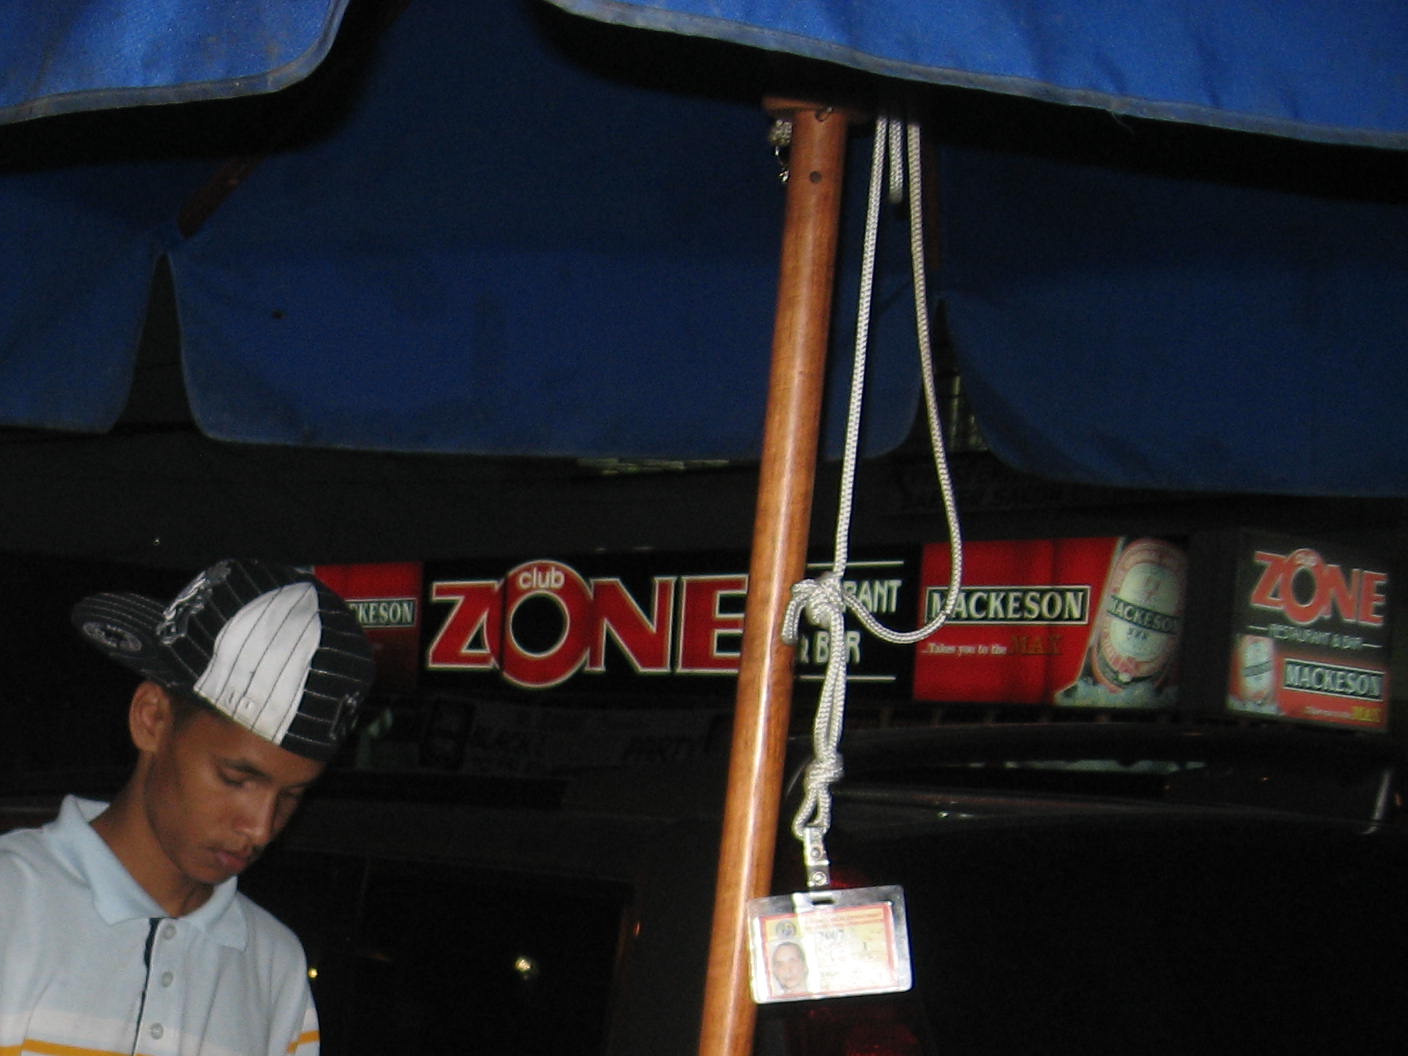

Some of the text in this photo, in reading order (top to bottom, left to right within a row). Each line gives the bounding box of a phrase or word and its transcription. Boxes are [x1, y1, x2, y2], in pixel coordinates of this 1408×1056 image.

[518, 567, 565, 591] club
[1250, 547, 1388, 626] ZONE
[930, 590, 1085, 620] MACKESON
[428, 560, 749, 689] ZONE
[1284, 662, 1383, 697] MACKESON
